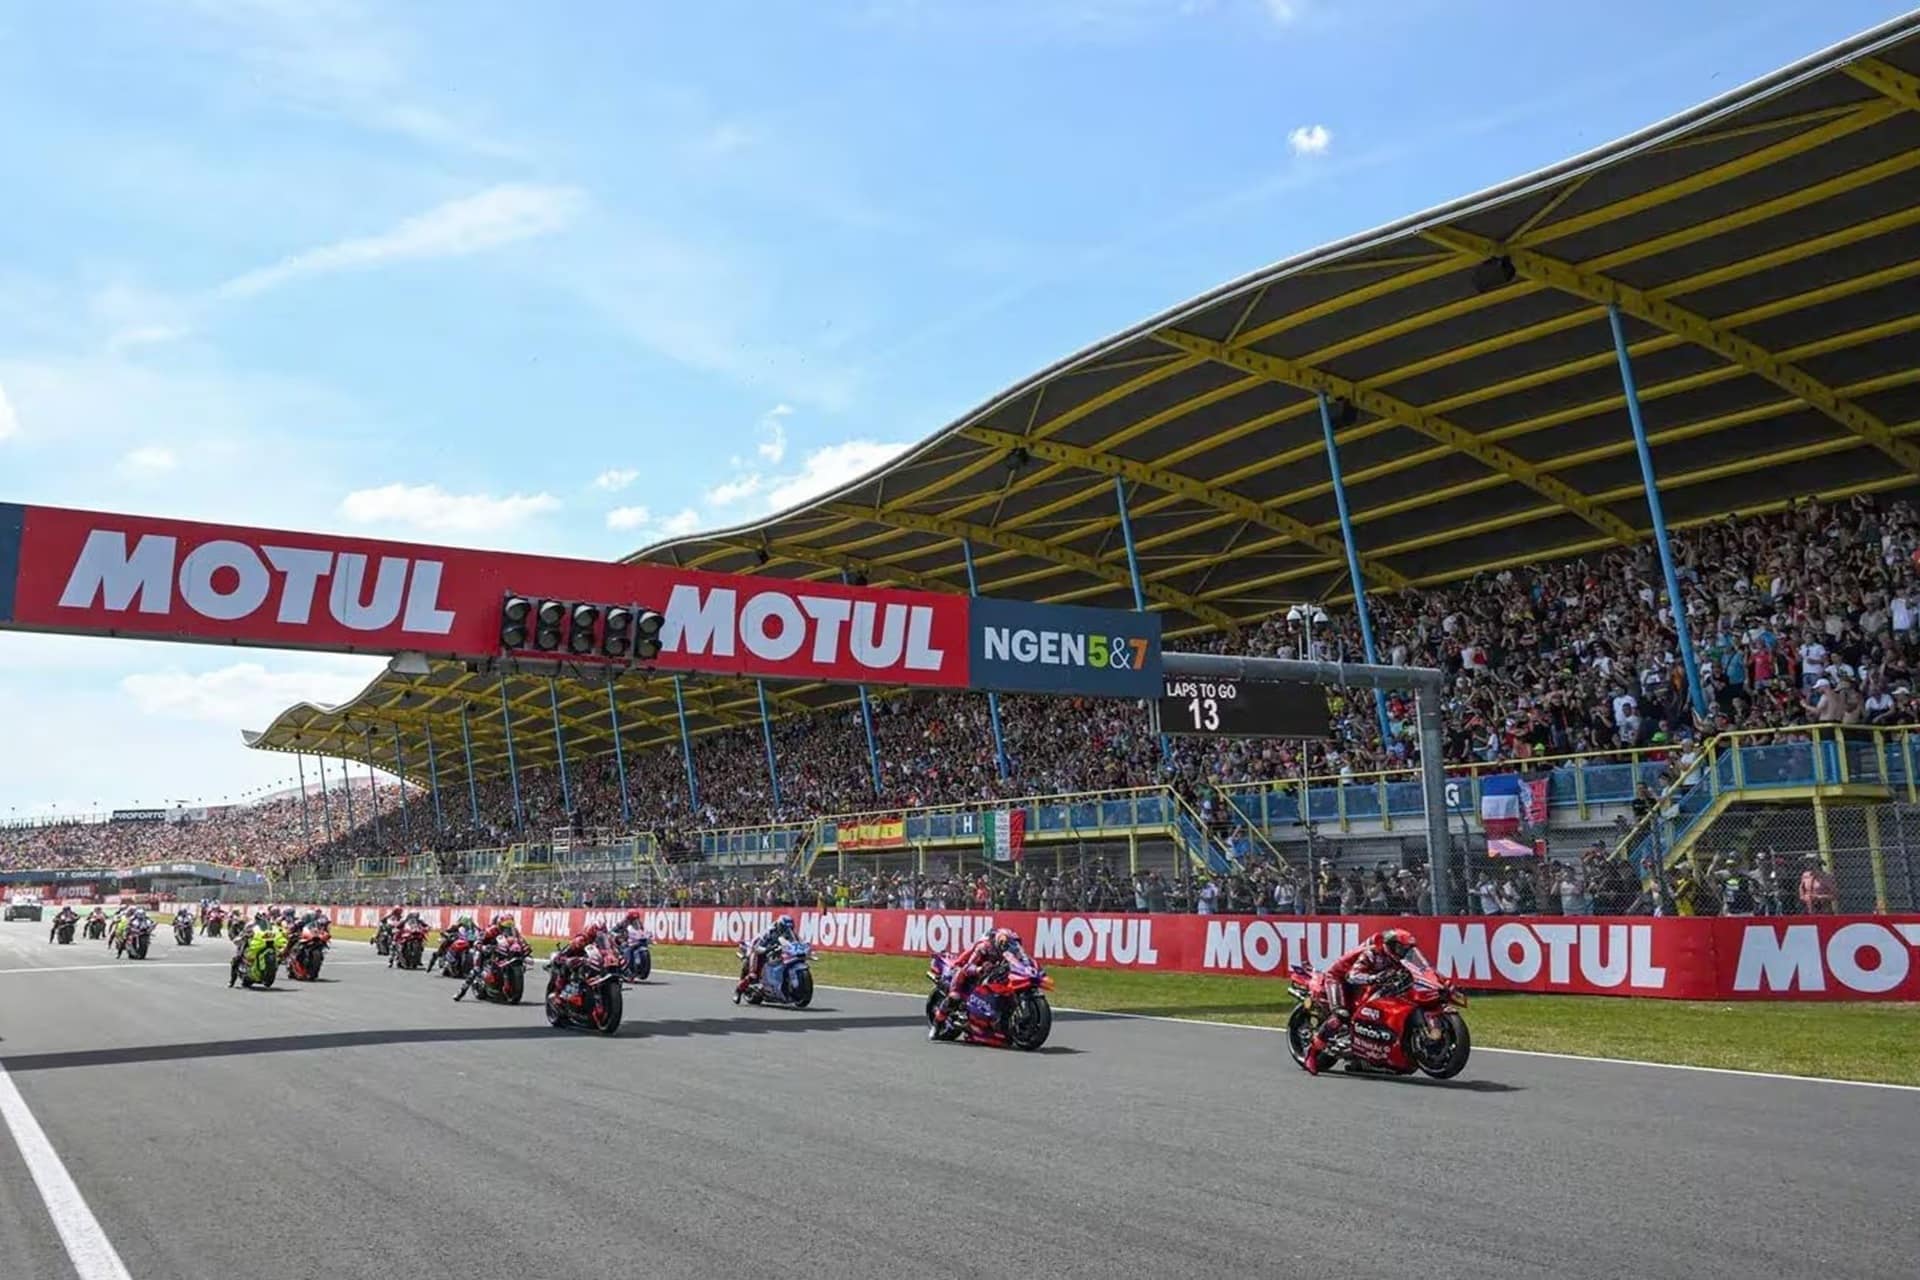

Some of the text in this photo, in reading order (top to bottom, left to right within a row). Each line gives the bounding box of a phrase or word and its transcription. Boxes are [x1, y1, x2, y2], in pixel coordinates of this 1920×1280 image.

[58, 529, 456, 635] MOTUL
[658, 584, 944, 670] MOTUL
[984, 626, 1148, 670] NGEN5&7
[1166, 682, 1237, 699] LAPS TO GO
[1188, 699, 1220, 731] 13
[1445, 783, 1460, 807] G
[963, 814, 973, 833] H
[56, 885, 92, 898] MOTUL
[532, 911, 570, 937] MOTUL
[798, 912, 875, 949] MOTUL
[1034, 917, 1158, 965] MOTUL
[1436, 923, 1667, 988] MOTUL
